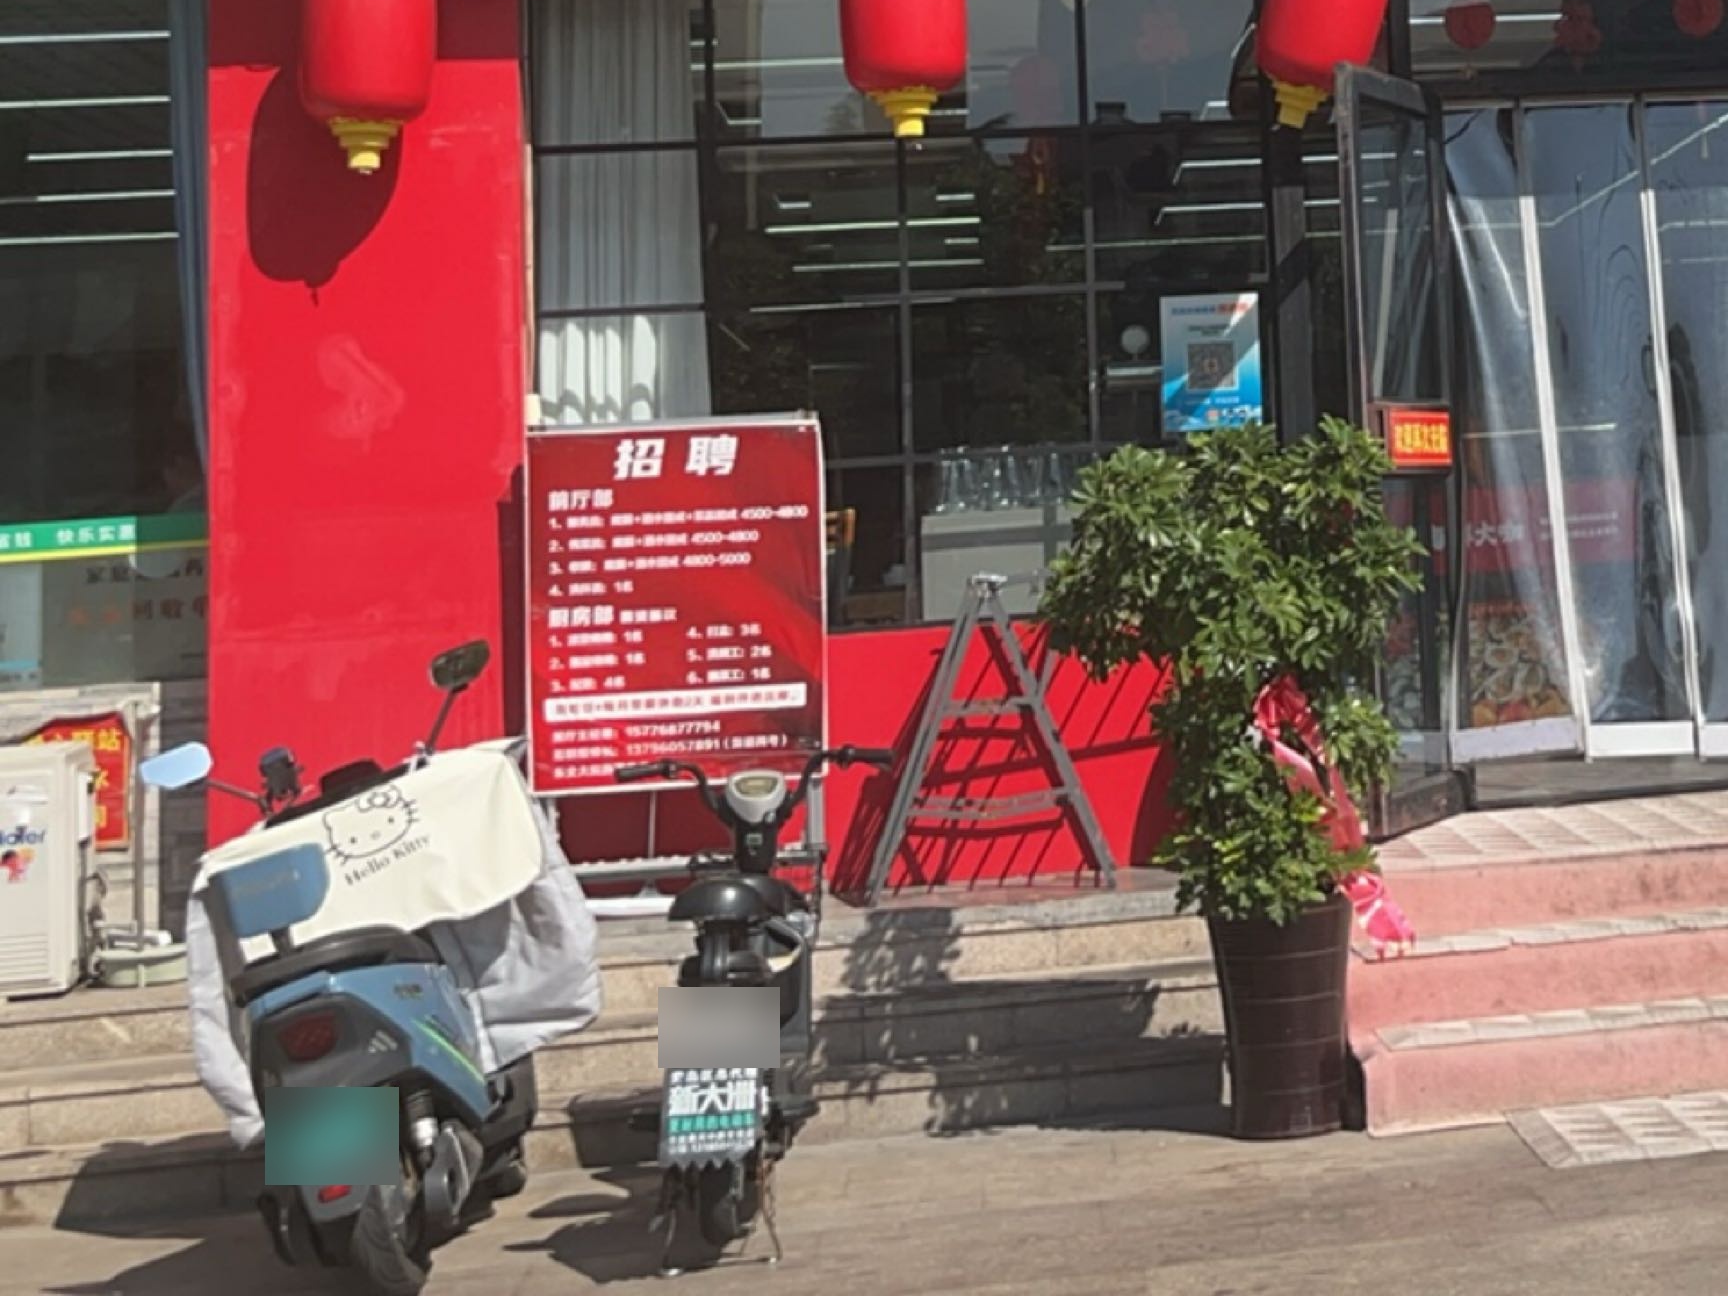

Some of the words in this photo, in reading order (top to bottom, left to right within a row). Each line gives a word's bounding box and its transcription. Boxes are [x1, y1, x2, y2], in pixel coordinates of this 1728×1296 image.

[613, 434, 739, 481] 招聘
[344, 854, 390, 885] Hello
[392, 834, 431, 860] Kitty
